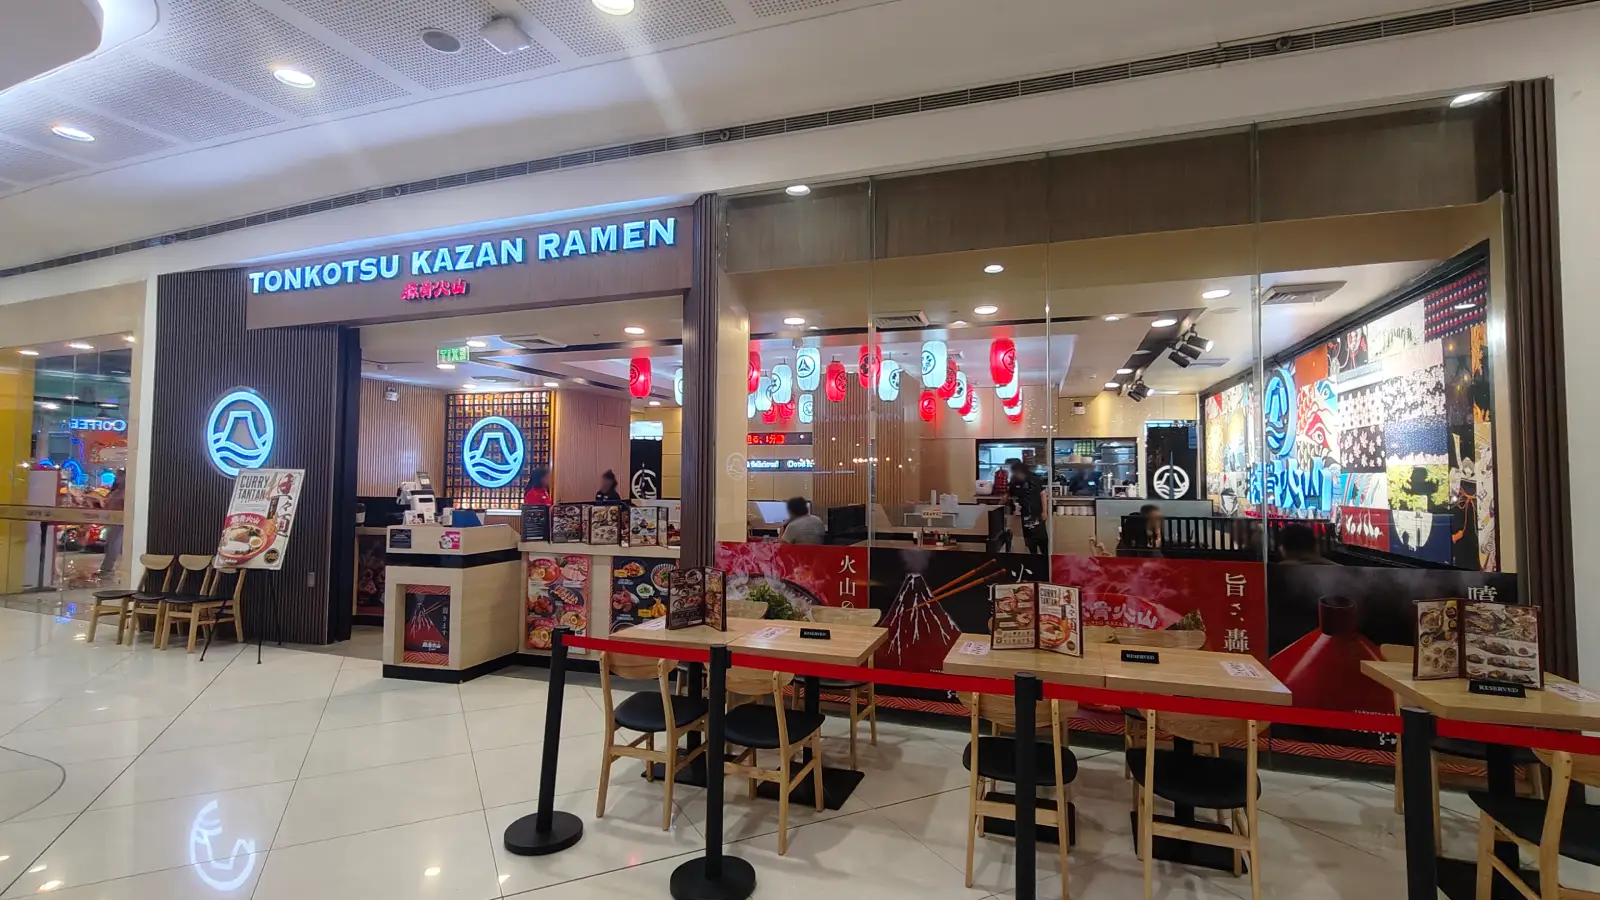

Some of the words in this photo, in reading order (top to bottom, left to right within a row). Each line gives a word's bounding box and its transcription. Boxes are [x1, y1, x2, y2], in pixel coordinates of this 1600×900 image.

[249, 255, 400, 294] TONKOTSU
[411, 238, 524, 276] KAZAN
[538, 218, 676, 261] RAMEN
[240, 475, 270, 488] CURRY
[1478, 684, 1519, 693] RESERVED
